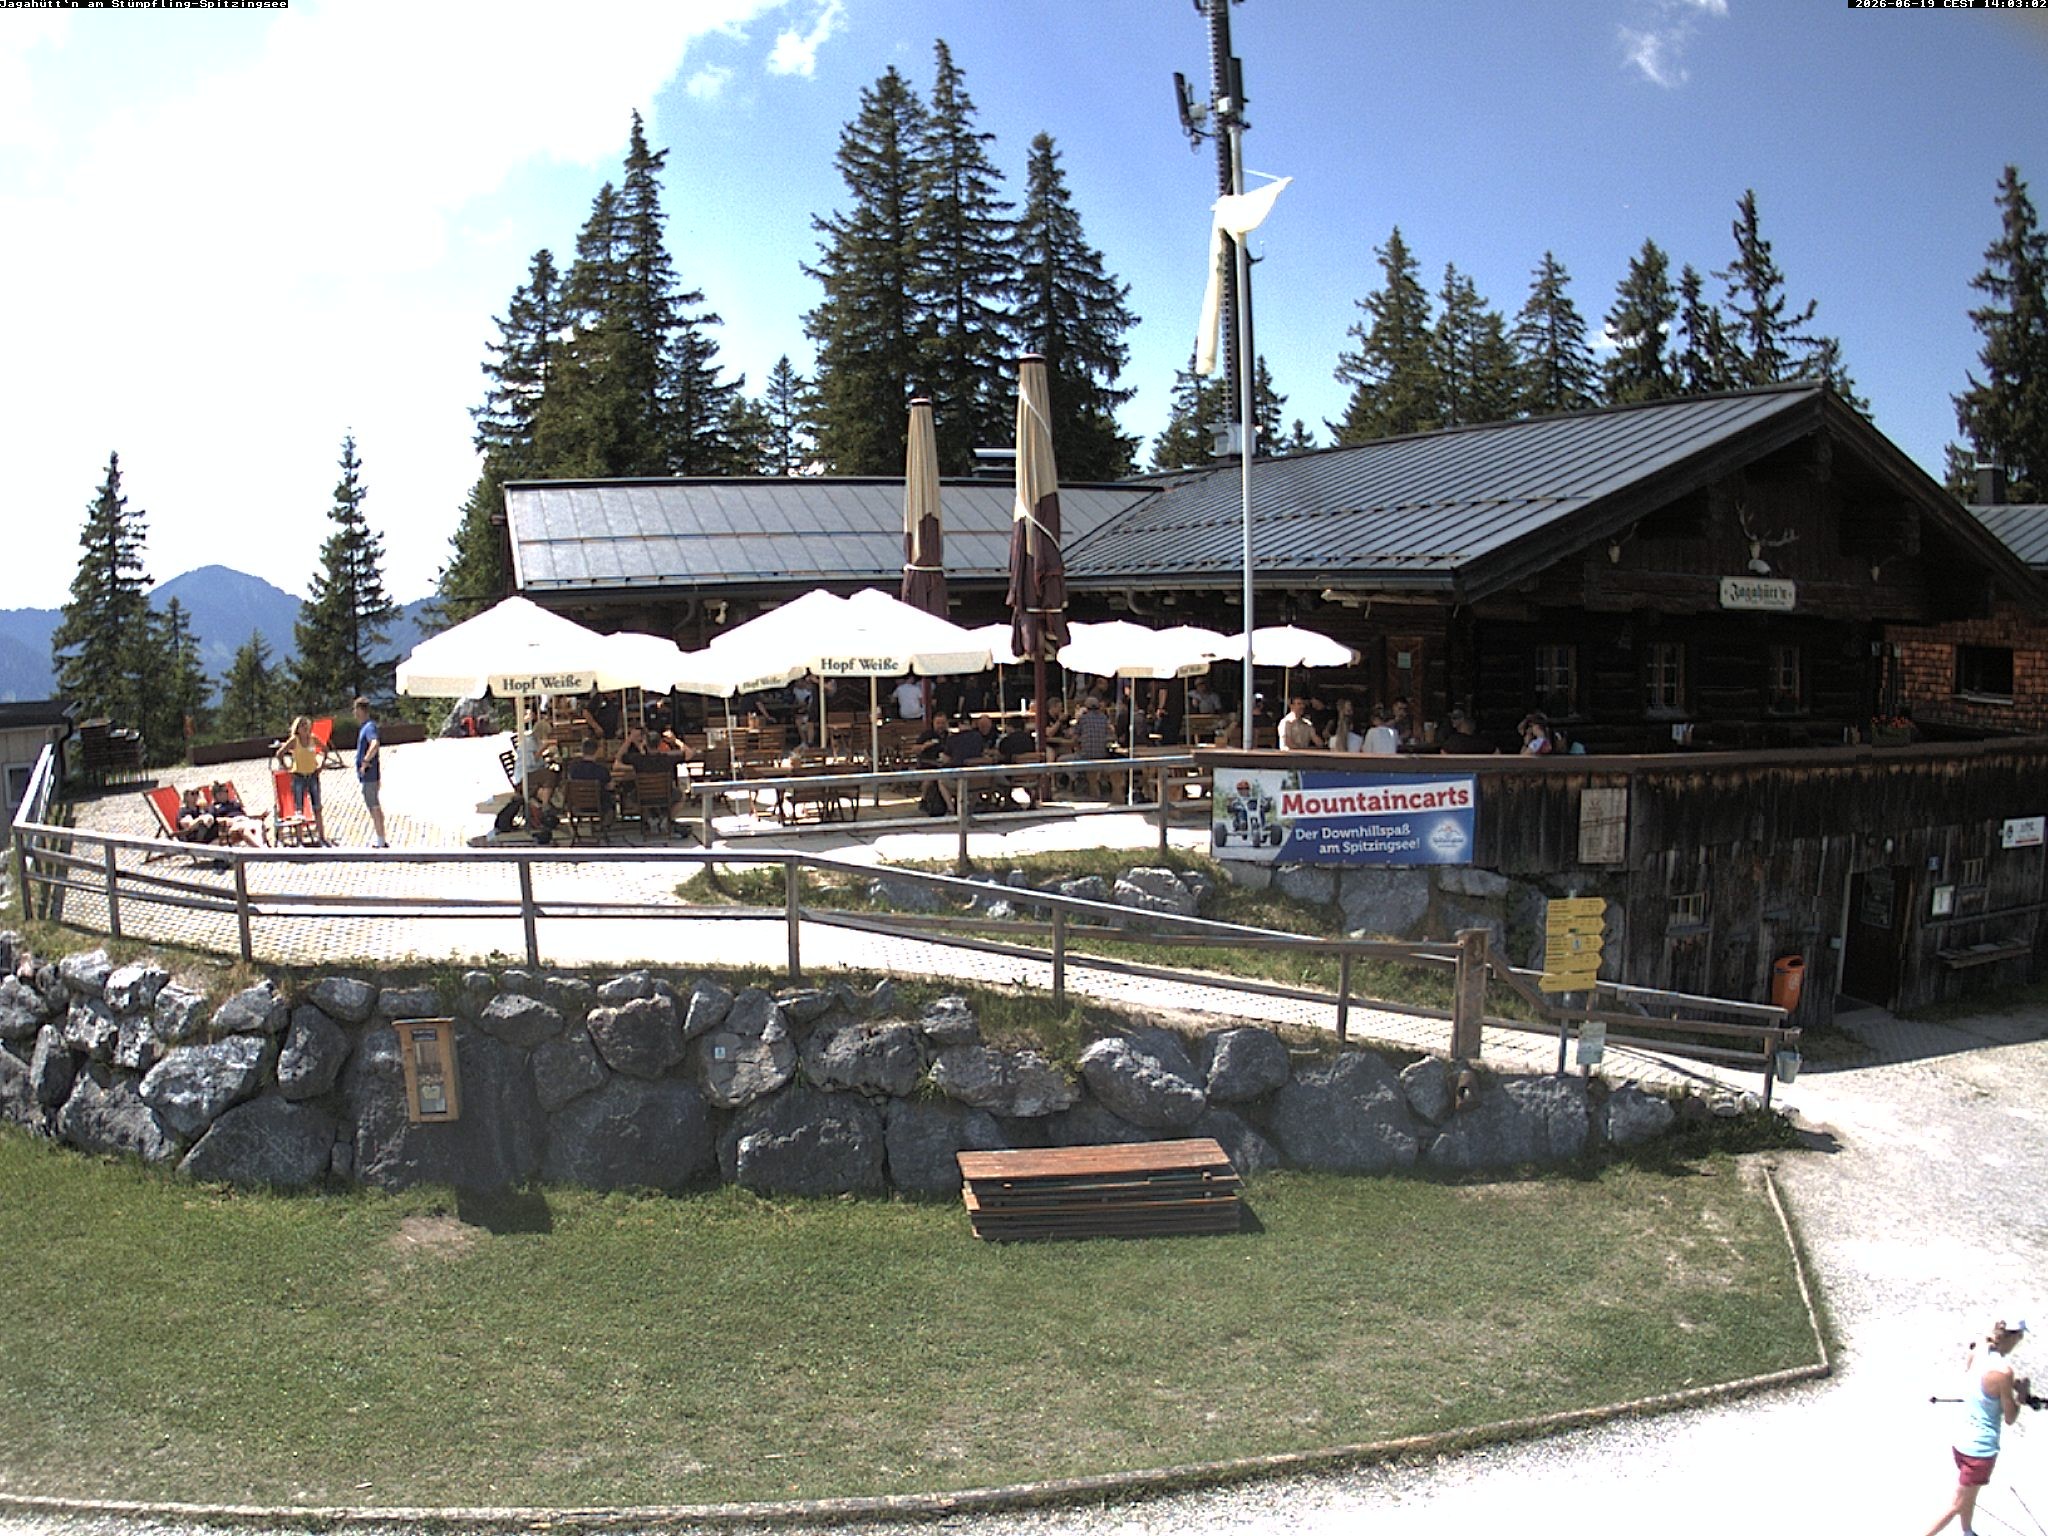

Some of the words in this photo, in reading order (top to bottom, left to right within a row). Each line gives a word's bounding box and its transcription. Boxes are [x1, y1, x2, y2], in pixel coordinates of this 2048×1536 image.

[820, 658, 855, 673] Hopf
[858, 657, 899, 670] Weiße
[503, 678, 538, 693] Hopf
[541, 675, 582, 688] Weiße
[1281, 786, 1470, 816] Mountaincarts
[1295, 828, 1319, 841] Der
[1321, 823, 1411, 840] Downhillspaß
[1319, 844, 1341, 854] am
[1342, 837, 1420, 855] Spitzingsee!
